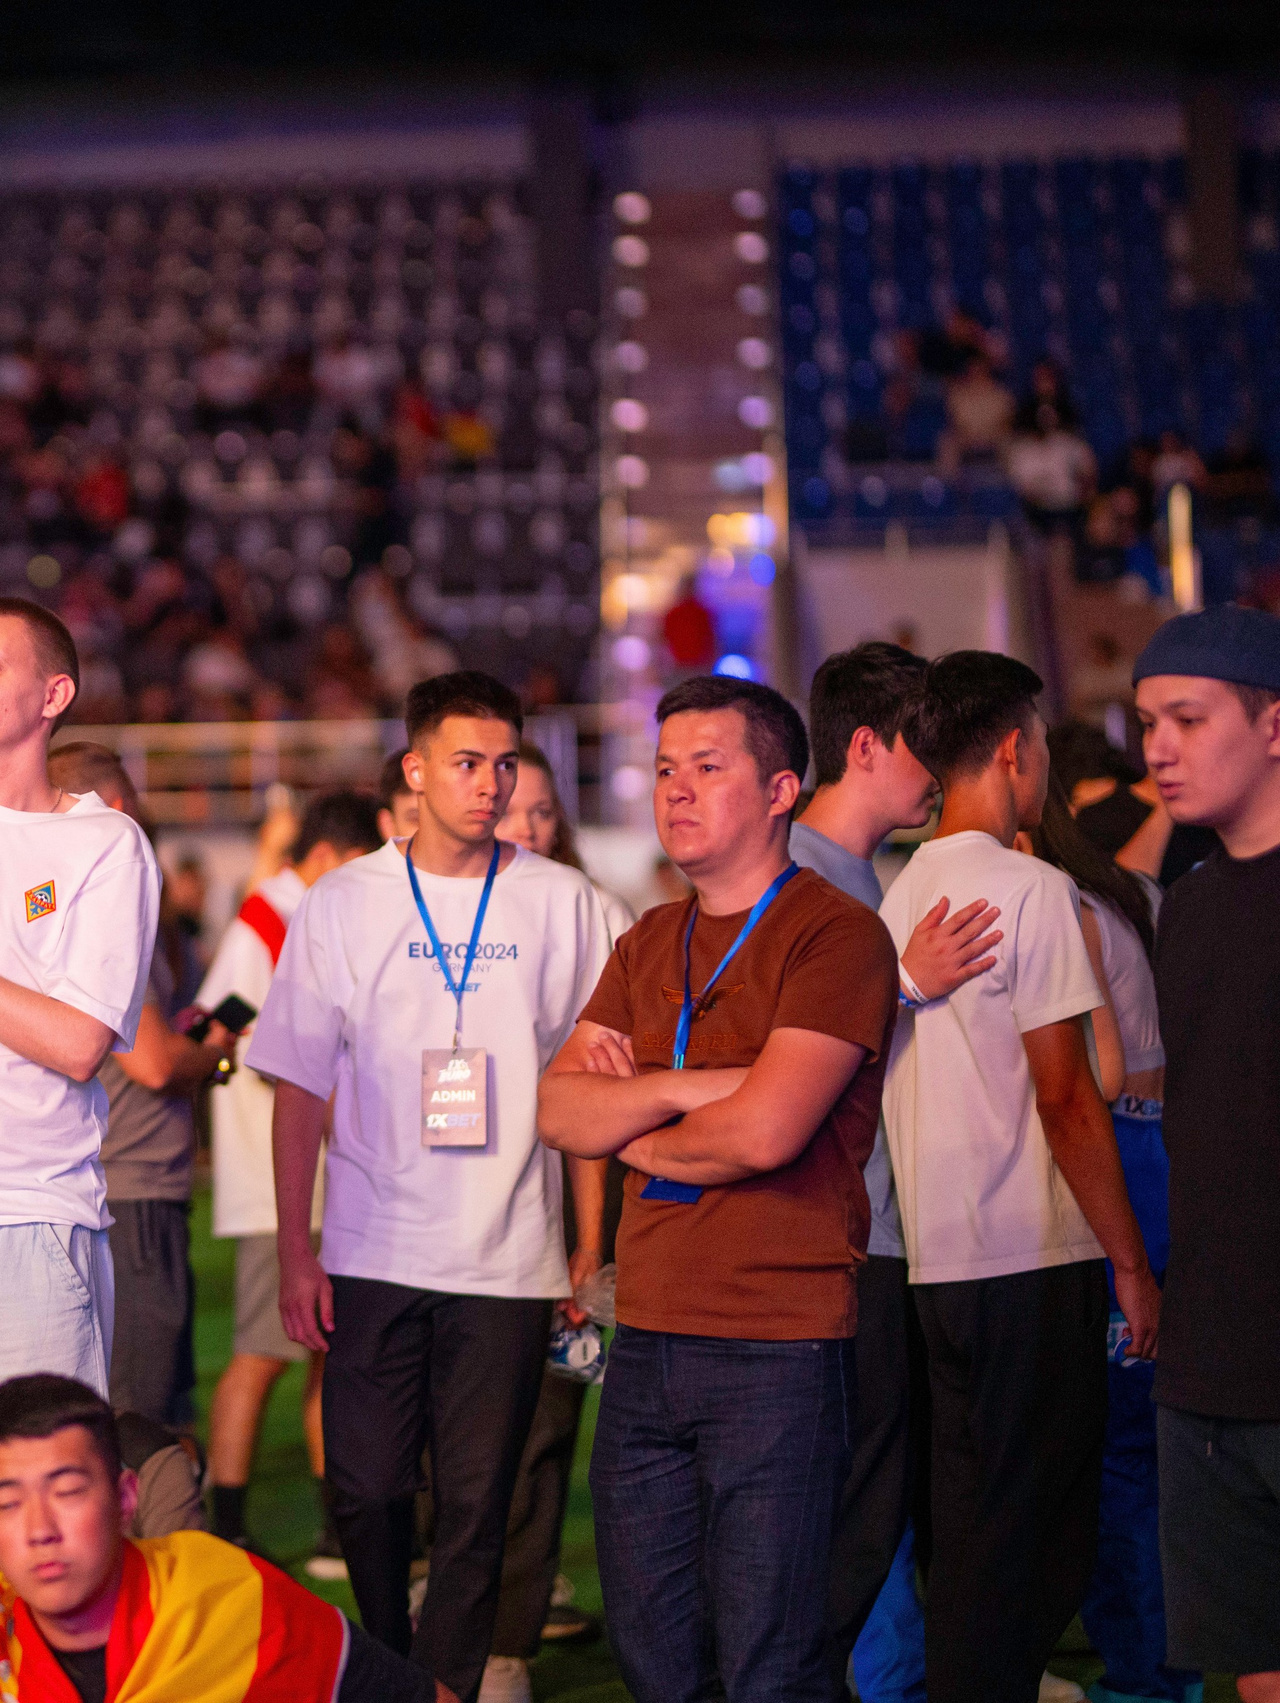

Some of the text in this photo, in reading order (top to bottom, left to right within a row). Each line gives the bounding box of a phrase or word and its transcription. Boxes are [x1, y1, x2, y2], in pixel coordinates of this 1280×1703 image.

[432, 962, 493, 973] GRMANY
[430, 1089, 476, 1103] ADMIN
[426, 1113, 481, 1129] 1XBET
